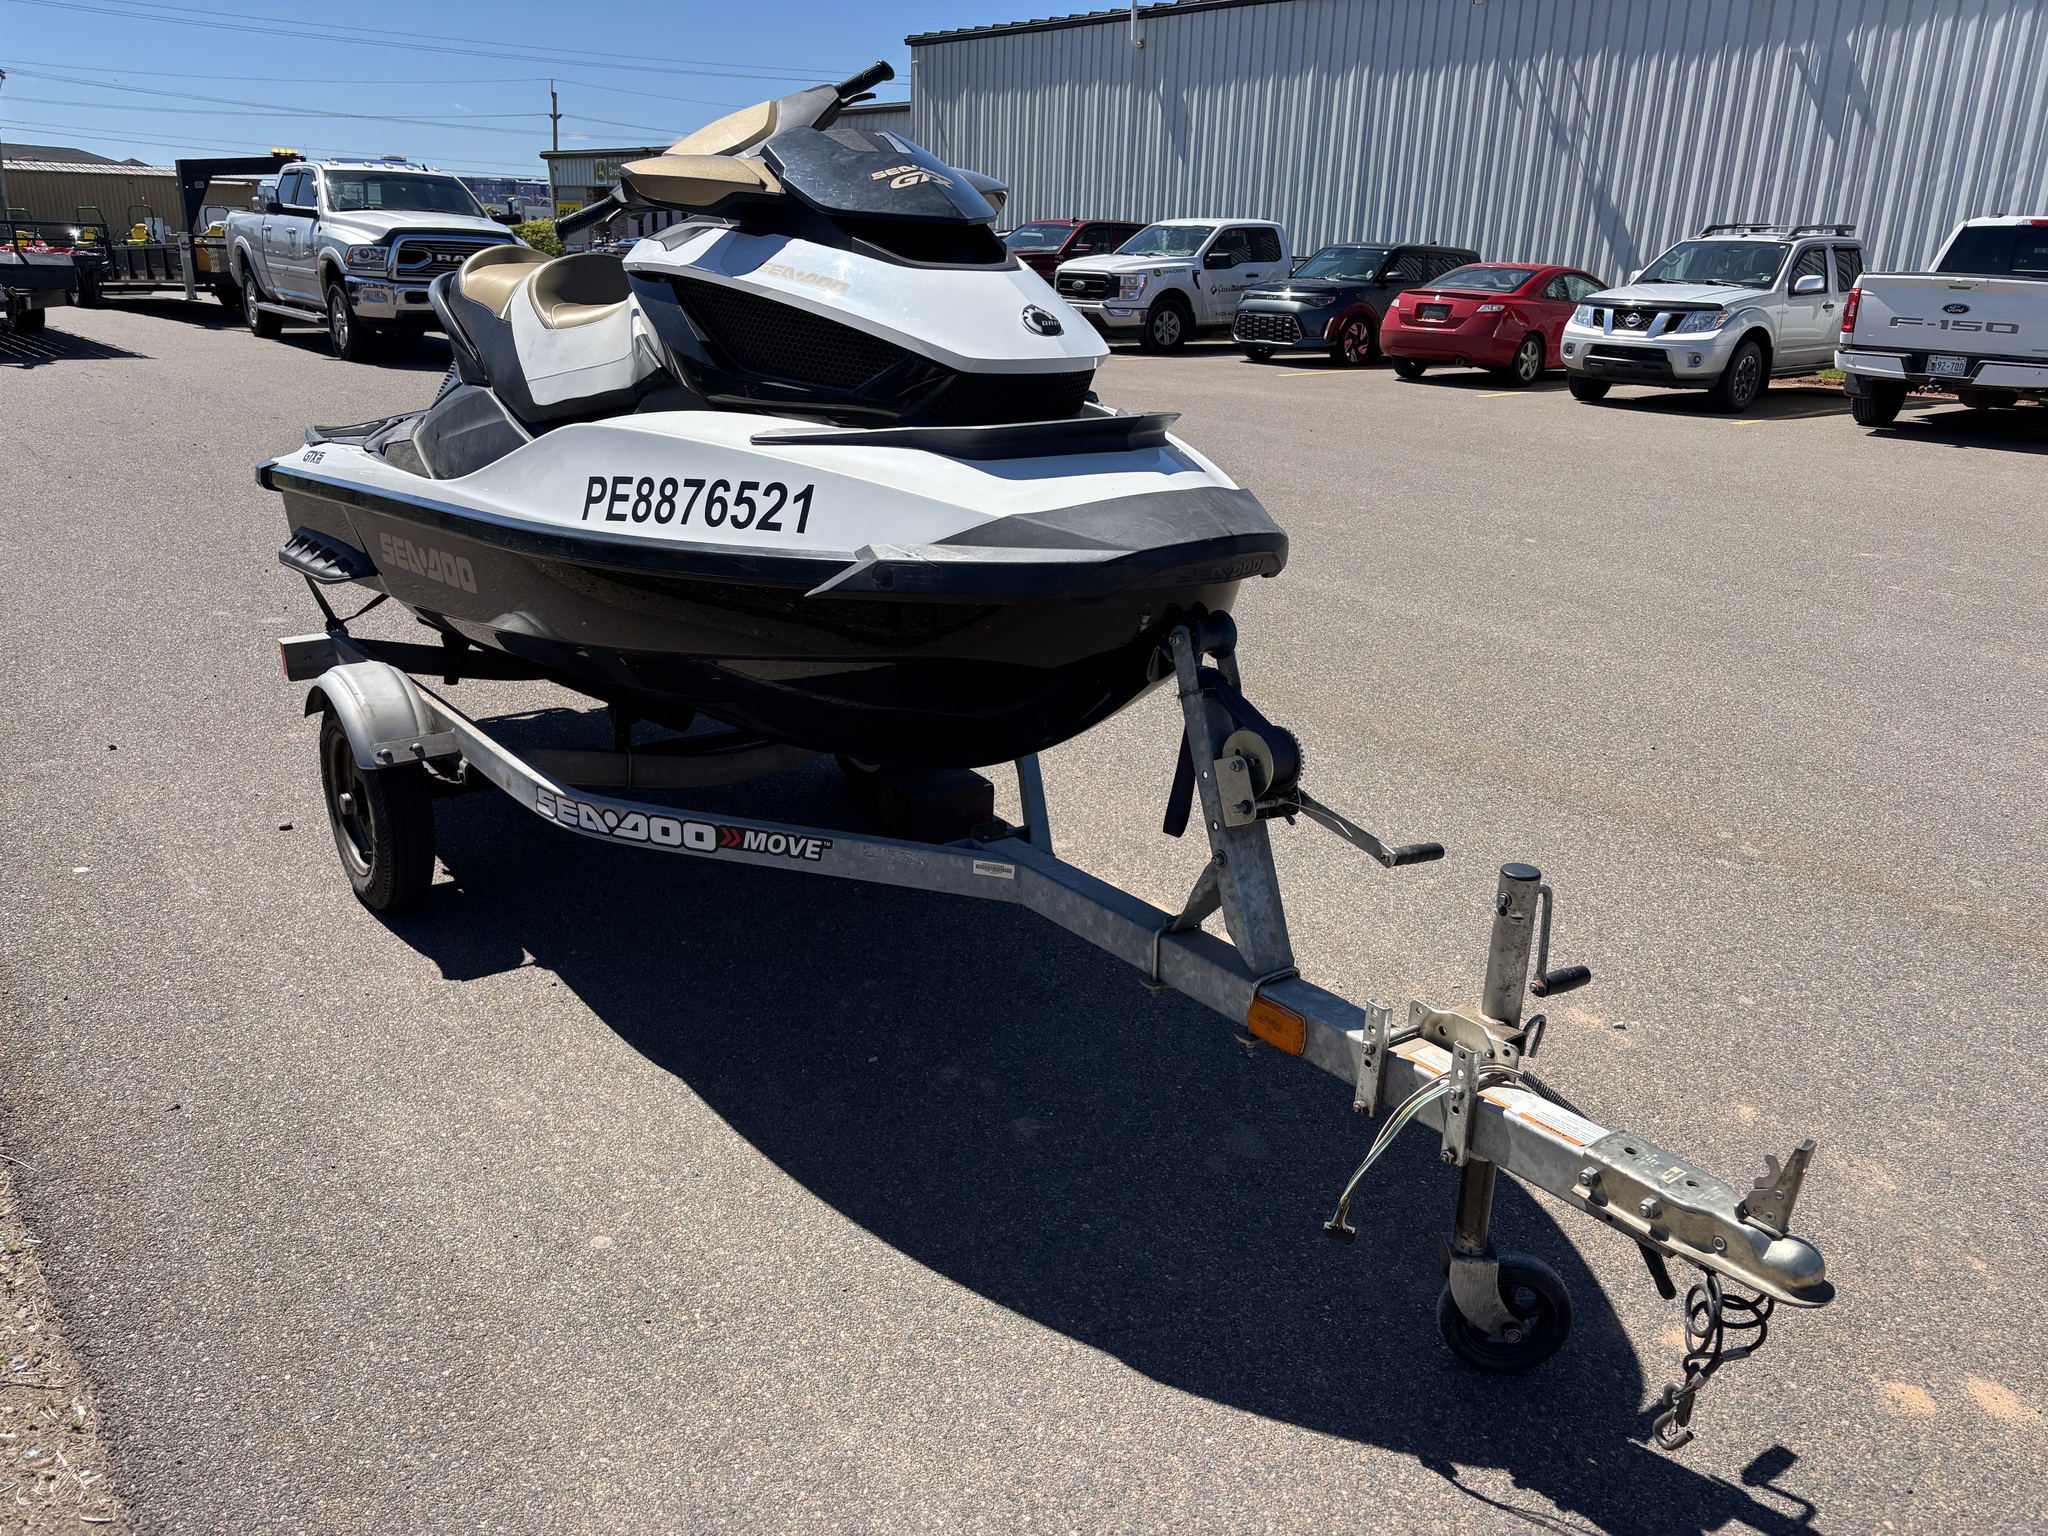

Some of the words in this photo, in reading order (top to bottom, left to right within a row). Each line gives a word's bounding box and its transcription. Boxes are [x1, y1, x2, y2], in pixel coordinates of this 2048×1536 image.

[608, 166, 620, 176] Gree
[436, 254, 470, 263] RA
[1889, 316, 2020, 335] F-150
[582, 475, 815, 534] PE8876521
